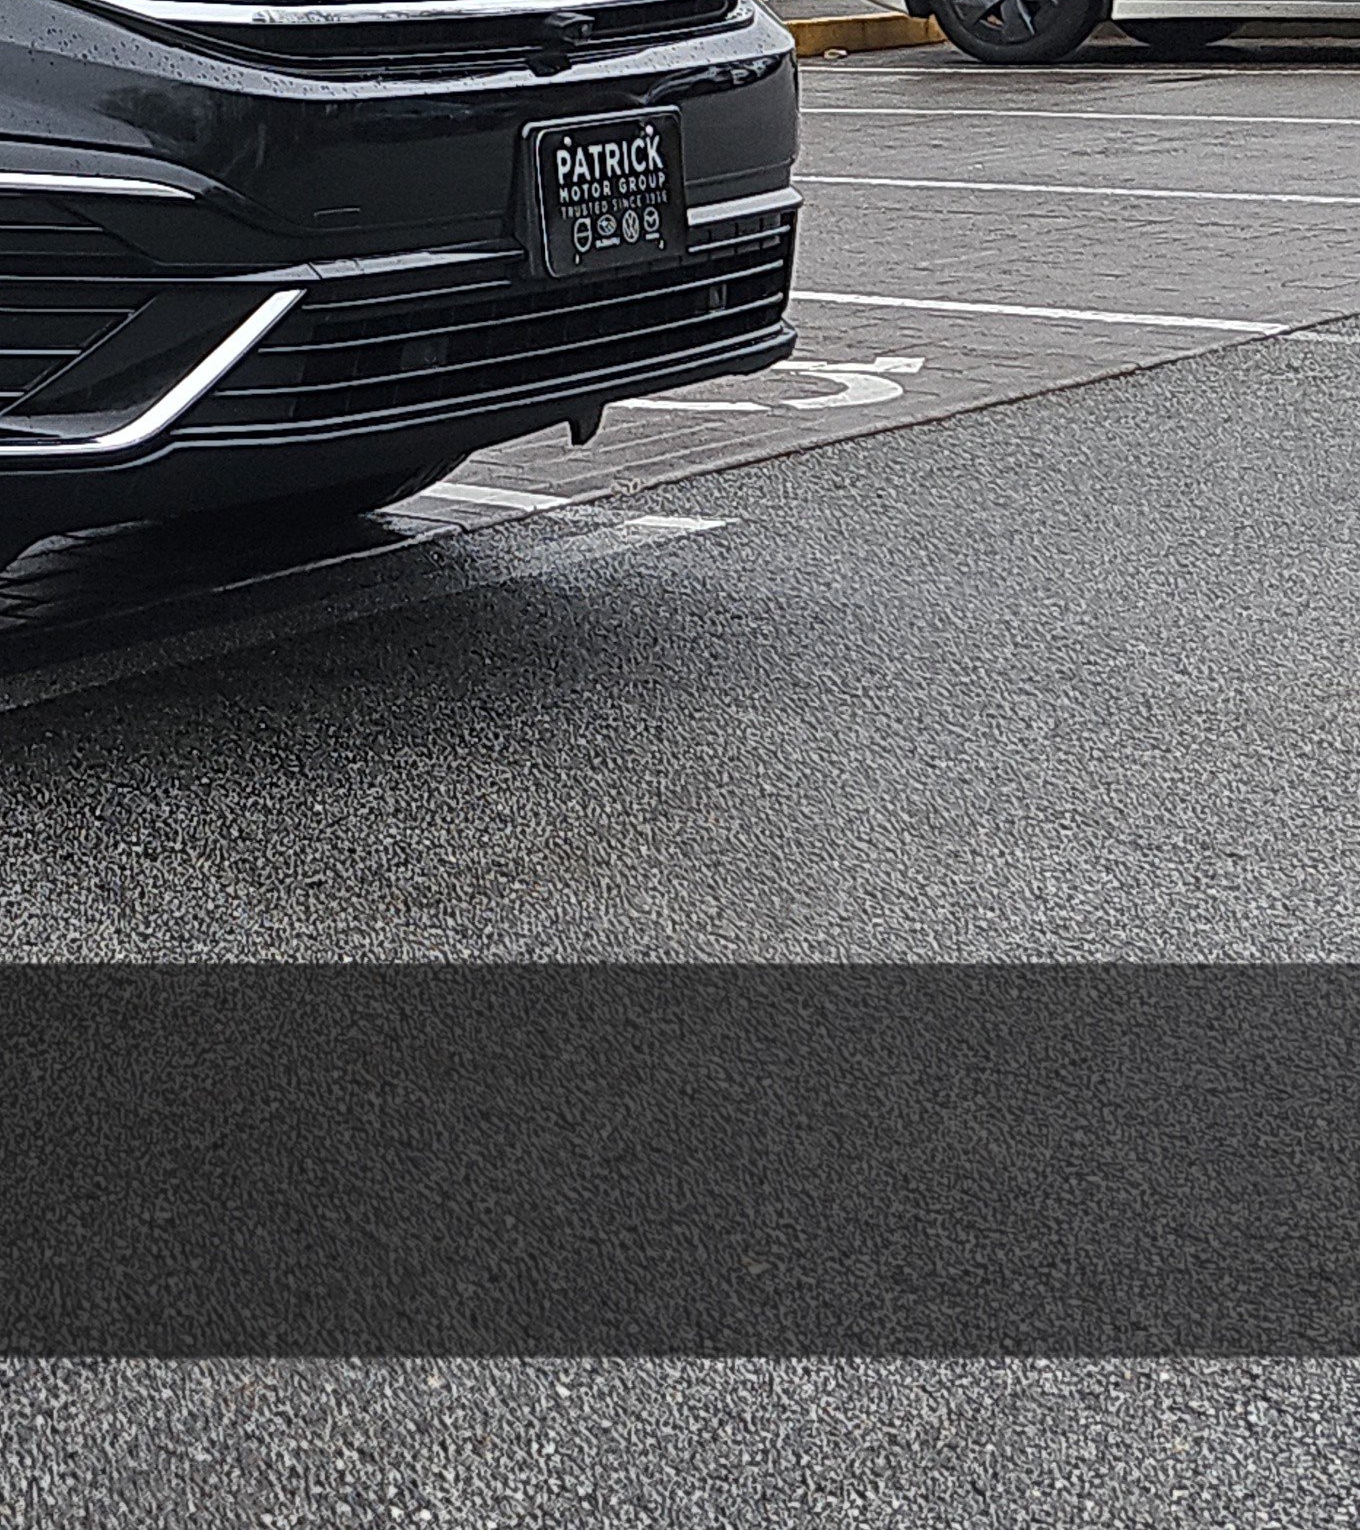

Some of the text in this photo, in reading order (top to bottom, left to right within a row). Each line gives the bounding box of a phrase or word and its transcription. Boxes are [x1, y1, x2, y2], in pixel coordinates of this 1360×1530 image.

[556, 134, 665, 185] PATRICK
[558, 171, 667, 204] MOTOR GROUP
[561, 201, 609, 220] TRUSTED
[612, 195, 643, 212] SINCE
